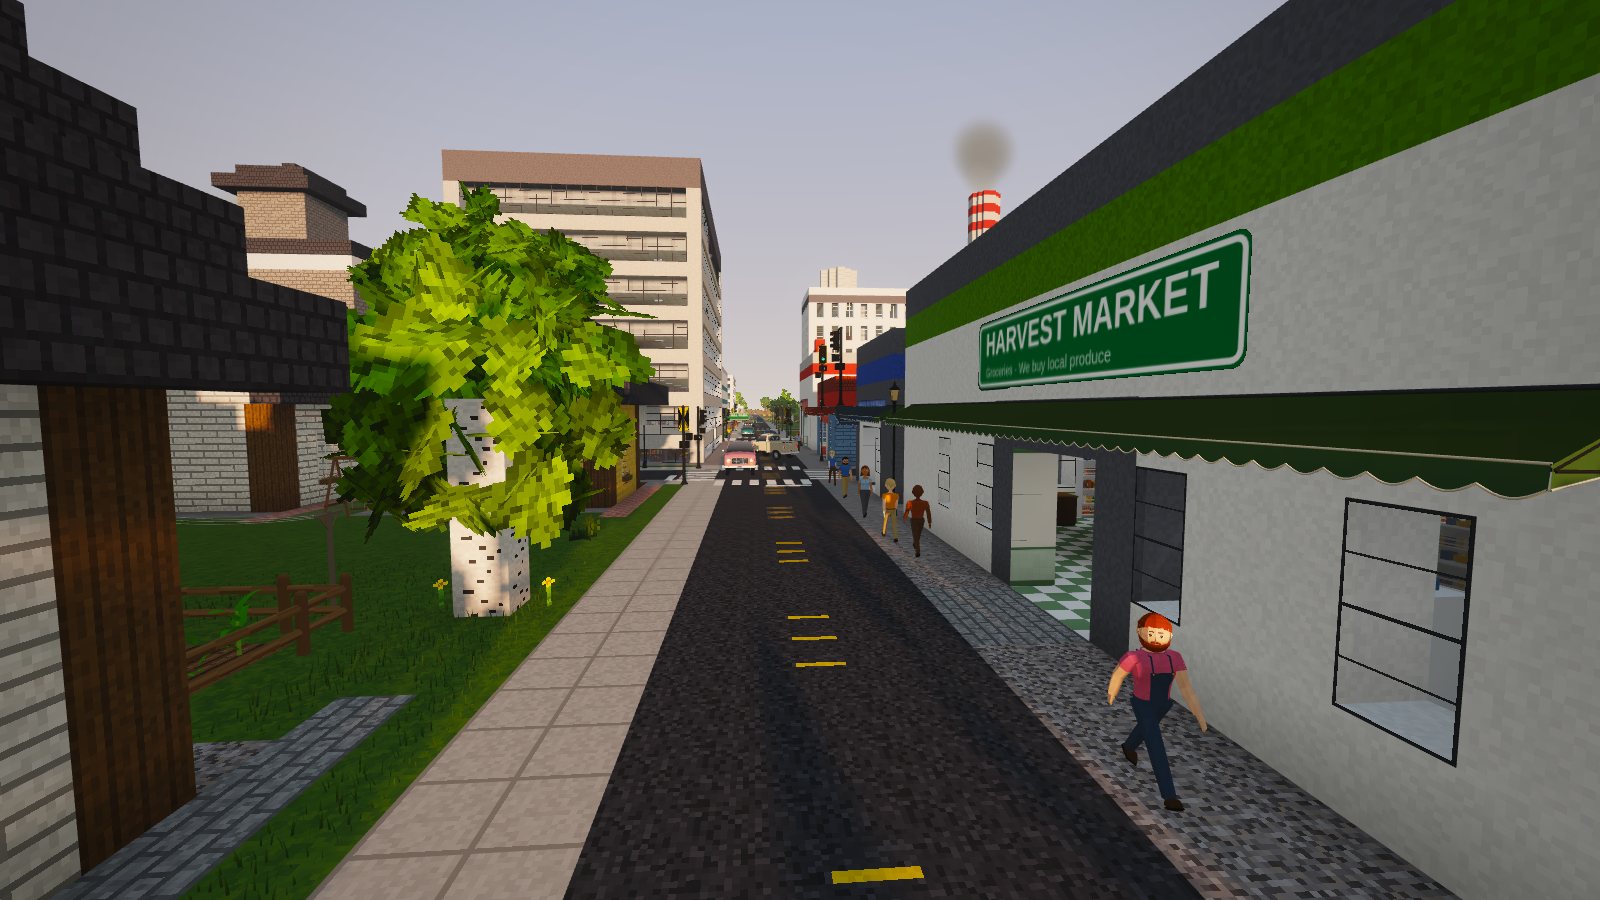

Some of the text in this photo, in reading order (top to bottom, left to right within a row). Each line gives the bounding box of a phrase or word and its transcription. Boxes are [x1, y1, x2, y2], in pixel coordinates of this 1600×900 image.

[986, 261, 1220, 358] HARVEST MARKET
[986, 364, 1013, 378] Groceries
[1018, 361, 1030, 375] We
[1031, 359, 1046, 376] buy
[1047, 353, 1068, 371] local
[1069, 348, 1112, 372] produce
